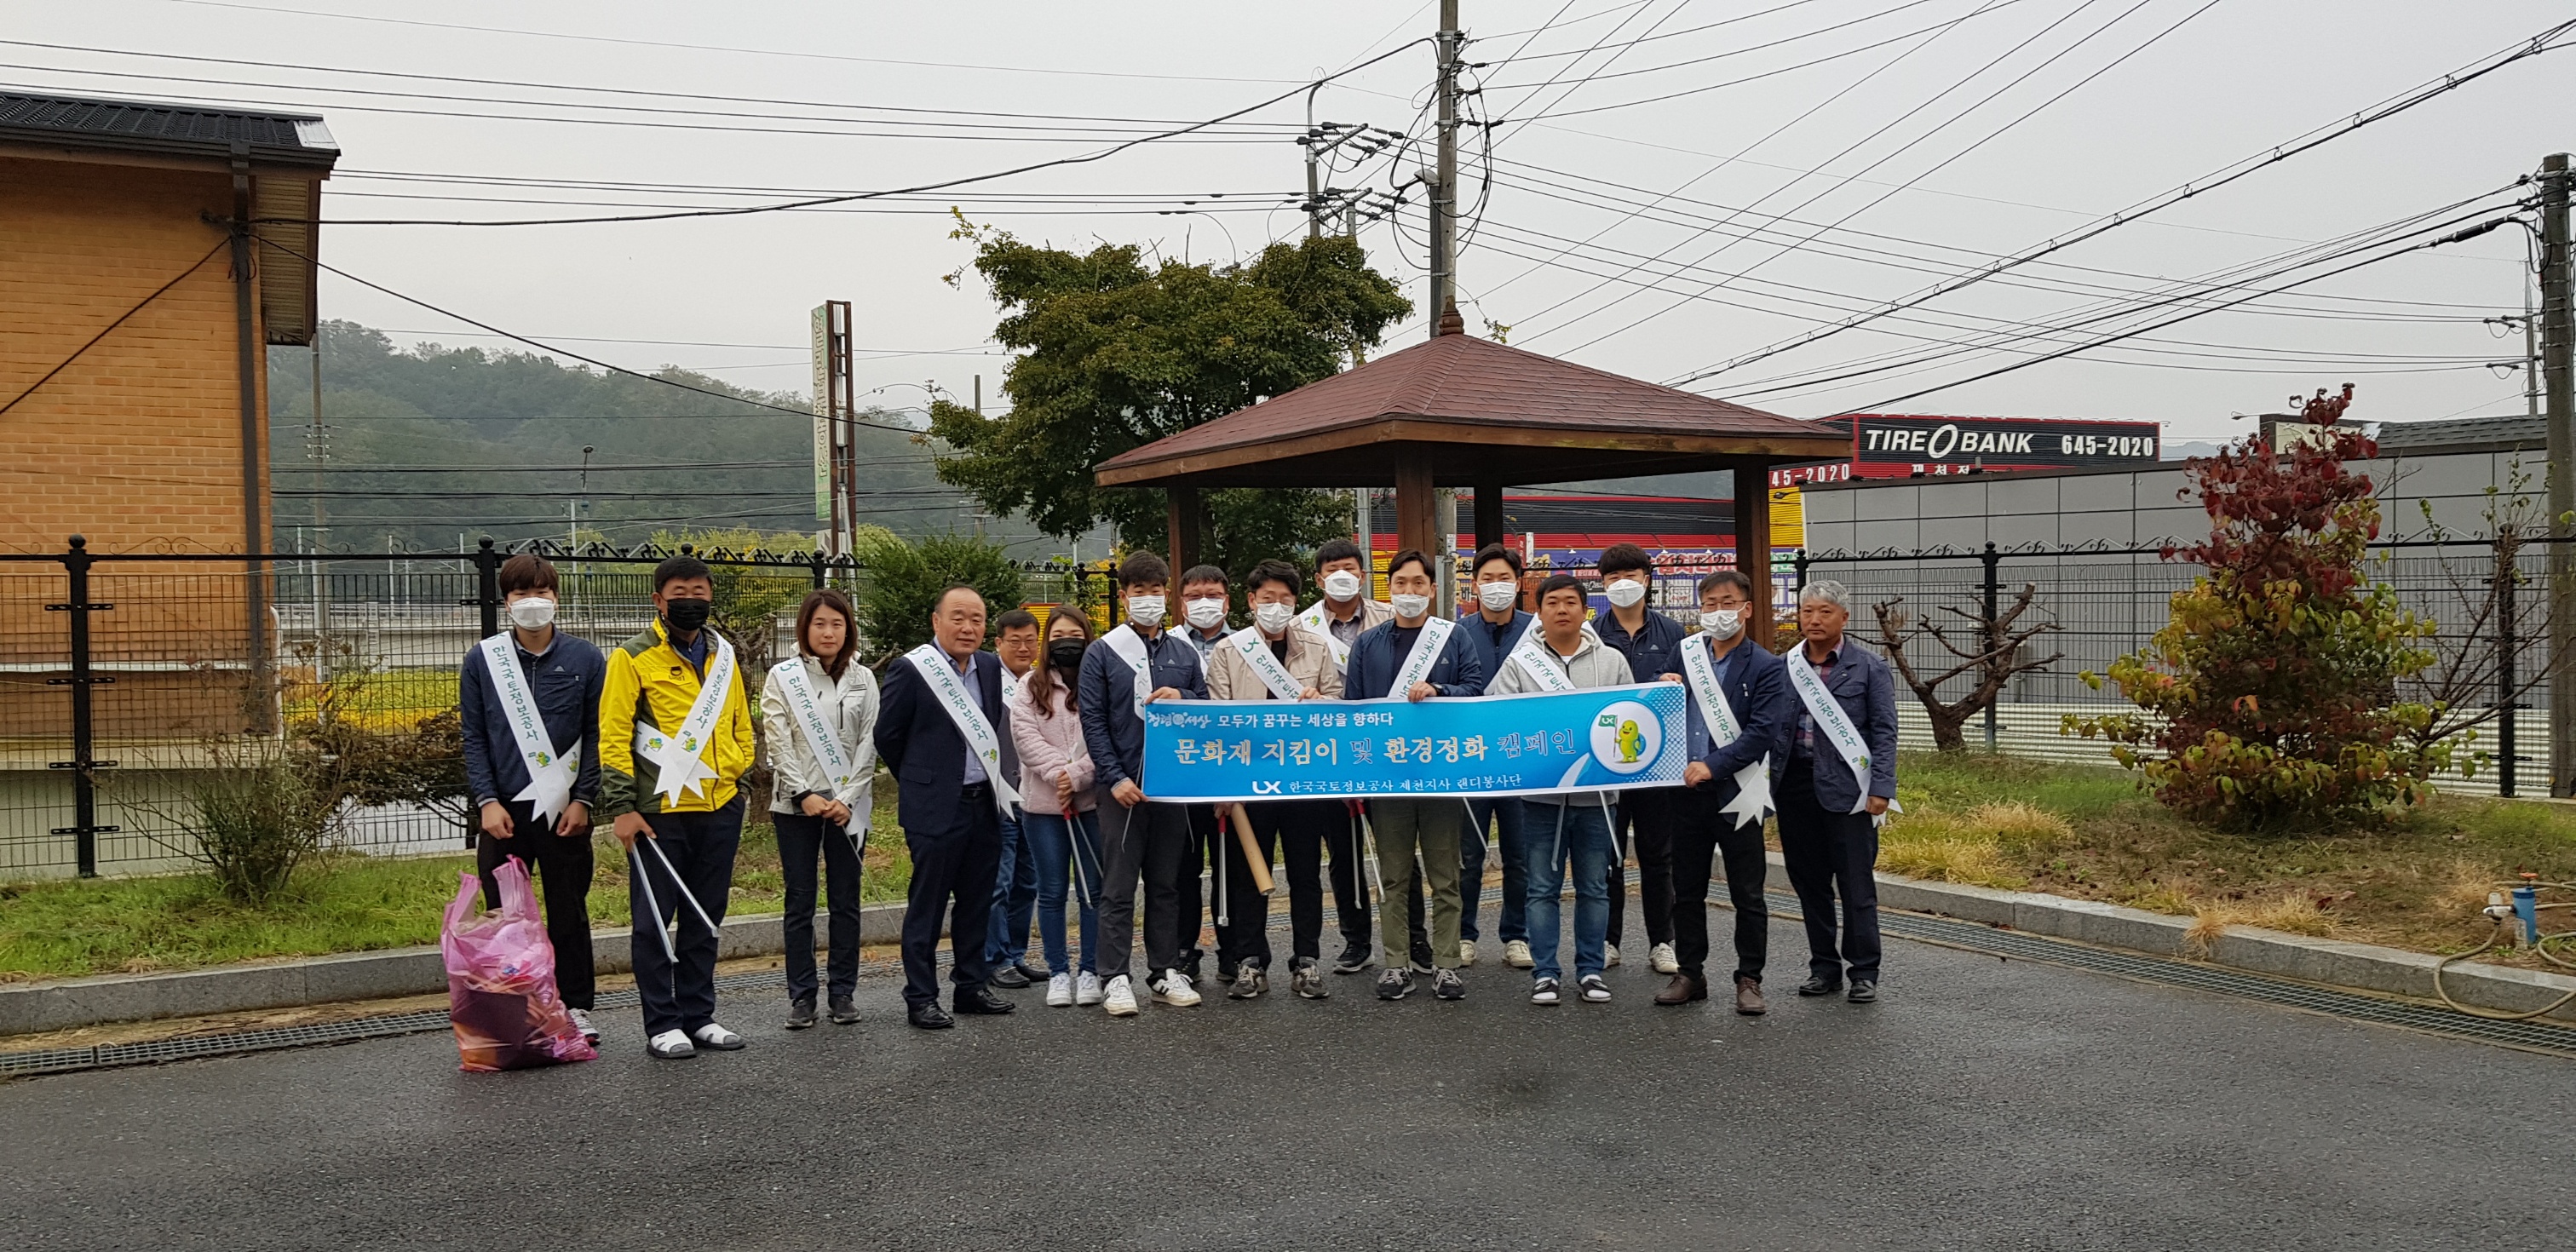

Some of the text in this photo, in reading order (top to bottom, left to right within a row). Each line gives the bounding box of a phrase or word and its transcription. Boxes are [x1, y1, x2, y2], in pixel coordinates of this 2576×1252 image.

[2061, 434, 2153, 457] 645-2020
[492, 645, 539, 741] 한국국토정보공사
[923, 656, 989, 741] 한국국토정보공사
[1523, 652, 1567, 691] 한국국토
[1691, 653, 1735, 741] 한국국토정보공사
[788, 675, 842, 767] 한국국토정보공사
[1216, 714, 1258, 728] 모두가
[1262, 713, 1302, 727] 꿈꾸는
[1307, 712, 1348, 727] 세상을
[1353, 711, 1394, 727] 향하다
[1795, 667, 1857, 747] 한국국토정보공사
[1174, 728, 1577, 766] 문화재 지킴이 및 환경정화 캠페인
[1289, 779, 1394, 793] 한국국토정보공사
[1399, 777, 1452, 792] 제천지사
[1457, 773, 1522, 790] 랜디봉사단
